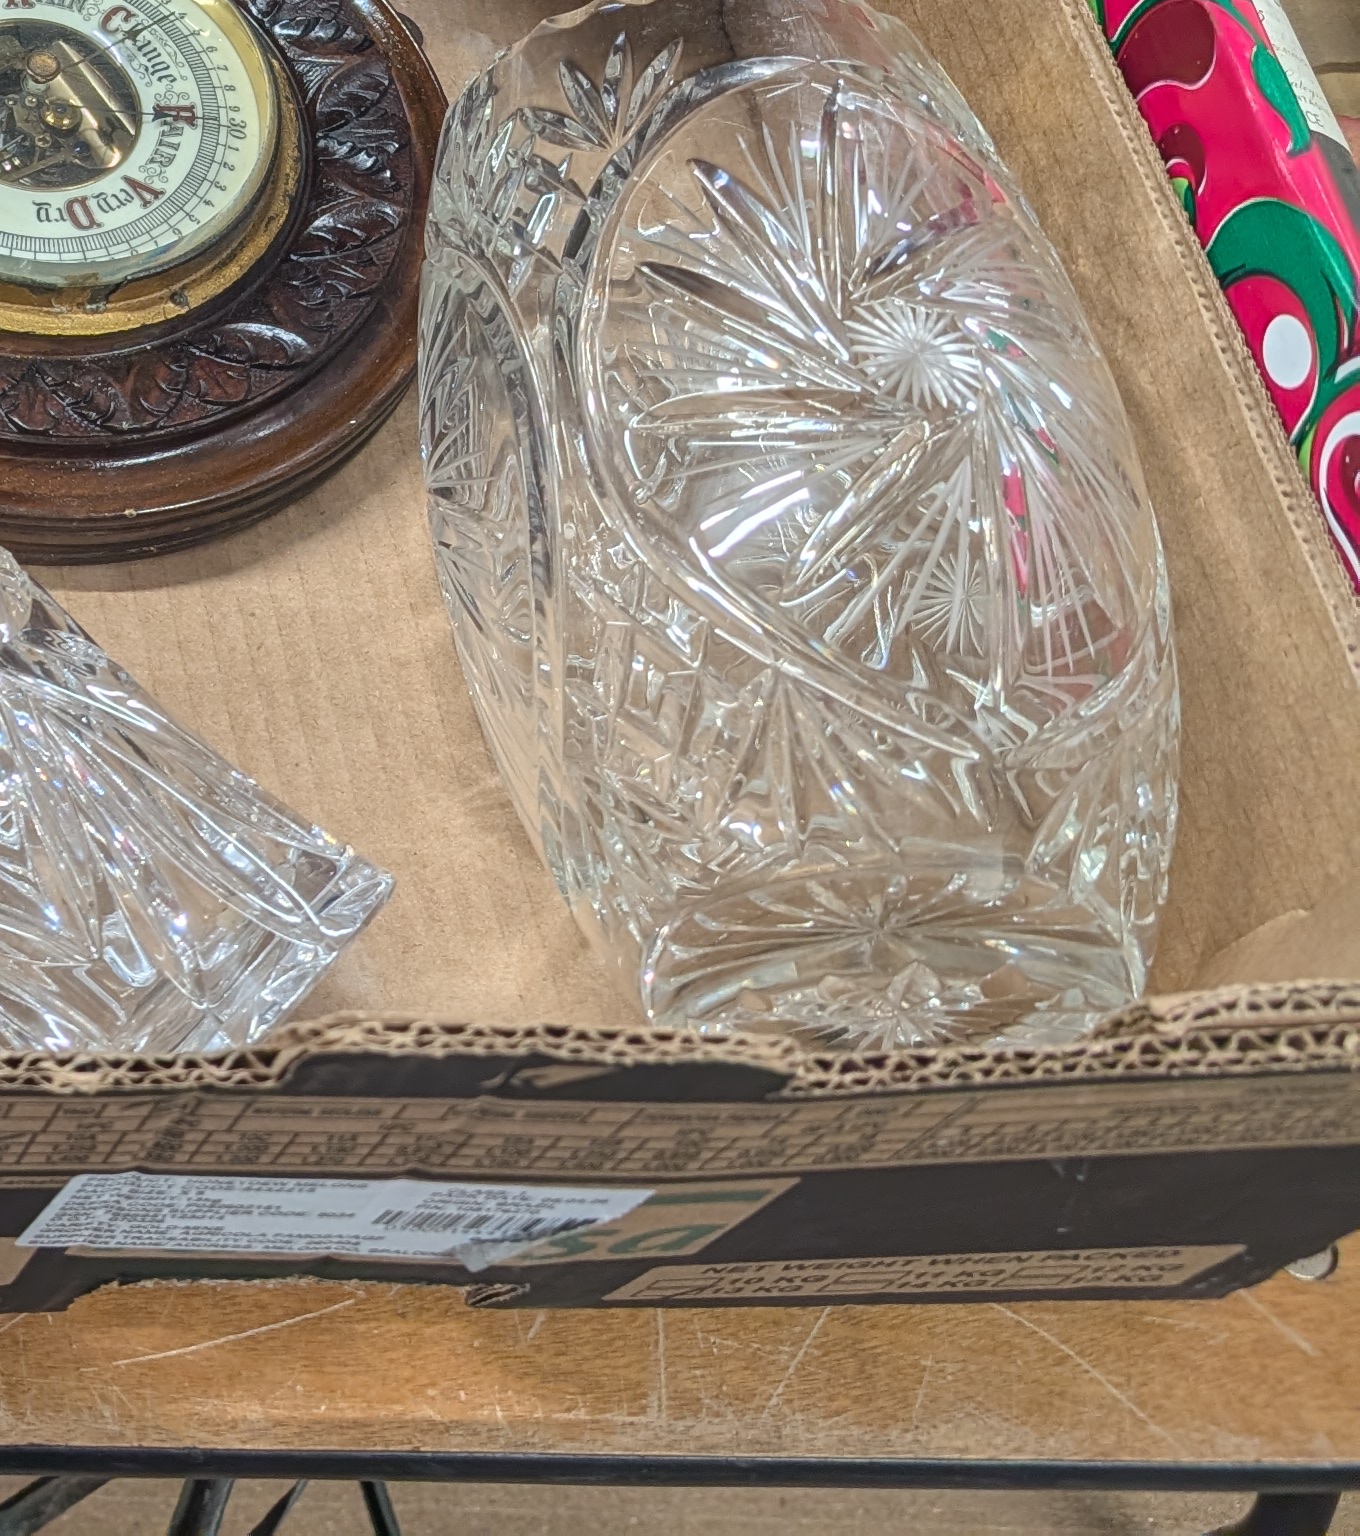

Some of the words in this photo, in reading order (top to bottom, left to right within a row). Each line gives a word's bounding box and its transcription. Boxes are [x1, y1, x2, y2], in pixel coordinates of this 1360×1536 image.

[229, 117, 247, 140] 30
[91, 174, 167, 214] Very
[32, 195, 105, 232] Dry
[702, 1264, 777, 1275] NET
